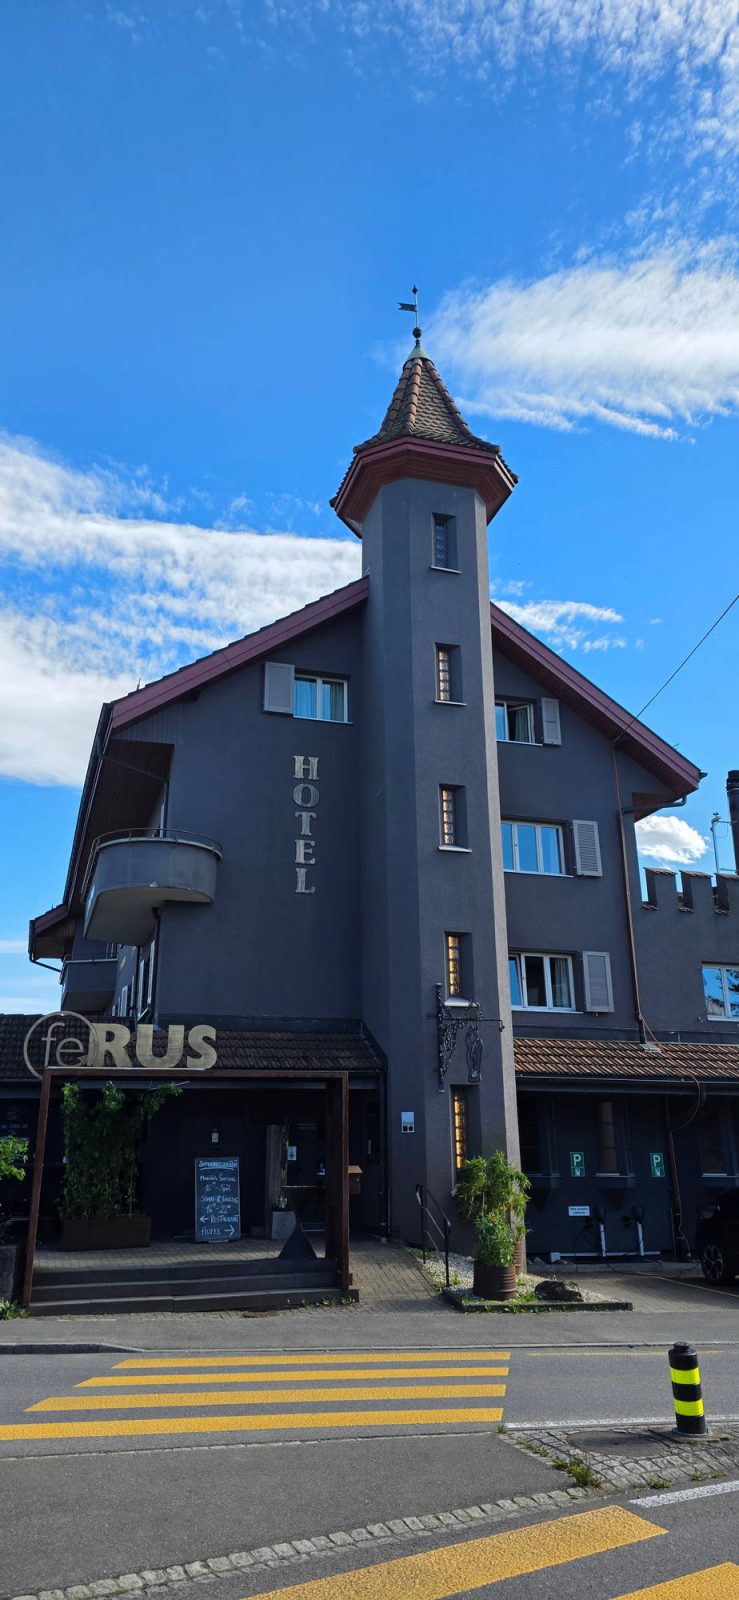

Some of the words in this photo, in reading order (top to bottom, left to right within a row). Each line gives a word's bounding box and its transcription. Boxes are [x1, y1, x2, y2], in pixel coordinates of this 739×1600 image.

[292, 755, 320, 894] HOTEL
[41, 1022, 218, 1070] feRUS
[573, 1154, 581, 1166] P
[653, 1155, 661, 1167] P
